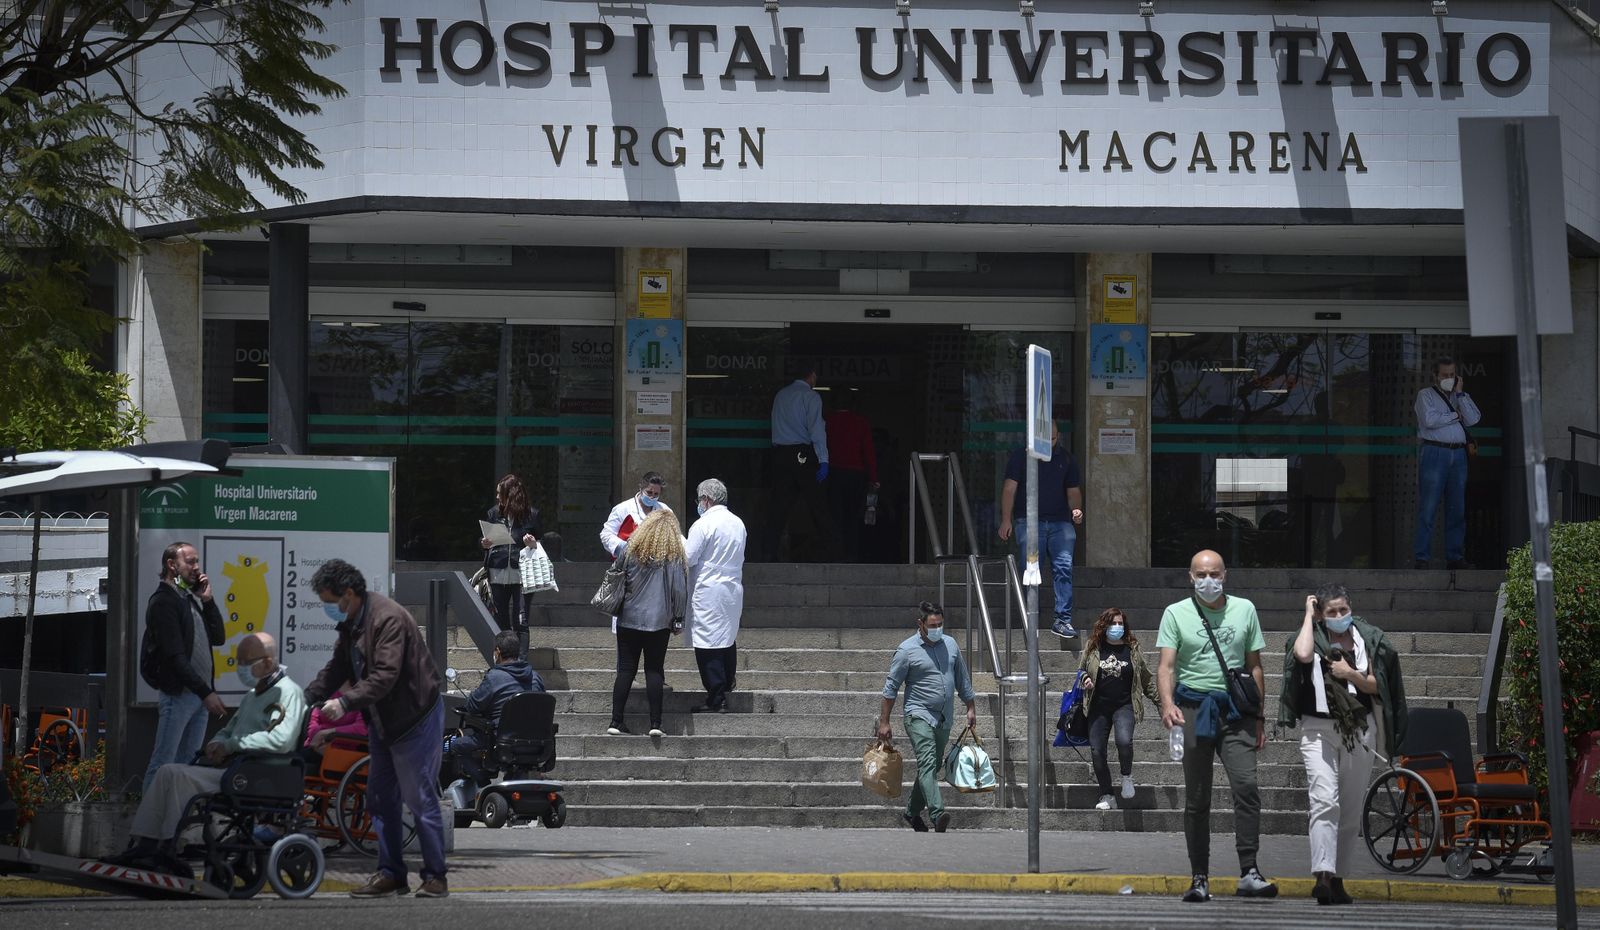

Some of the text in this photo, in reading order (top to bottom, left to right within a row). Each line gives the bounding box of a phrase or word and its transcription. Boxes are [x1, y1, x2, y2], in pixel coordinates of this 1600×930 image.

[379, 17, 1531, 88] HOSPITAL UNIVERSITARIO
[541, 124, 1368, 173] VIRGEN MACARENA
[571, 339, 613, 354] SÓLO
[706, 354, 768, 370] DONAR
[784, 358, 890, 377] ETRADA
[1157, 359, 1223, 375] DONAR
[214, 483, 317, 501] Hospital Universitario
[214, 505, 297, 522] Virgen Macarena
[288, 550, 297, 567] 1
[286, 570, 297, 588] 2
[286, 591, 297, 609] 3
[286, 614, 297, 632] 4
[286, 636, 297, 654] 5
